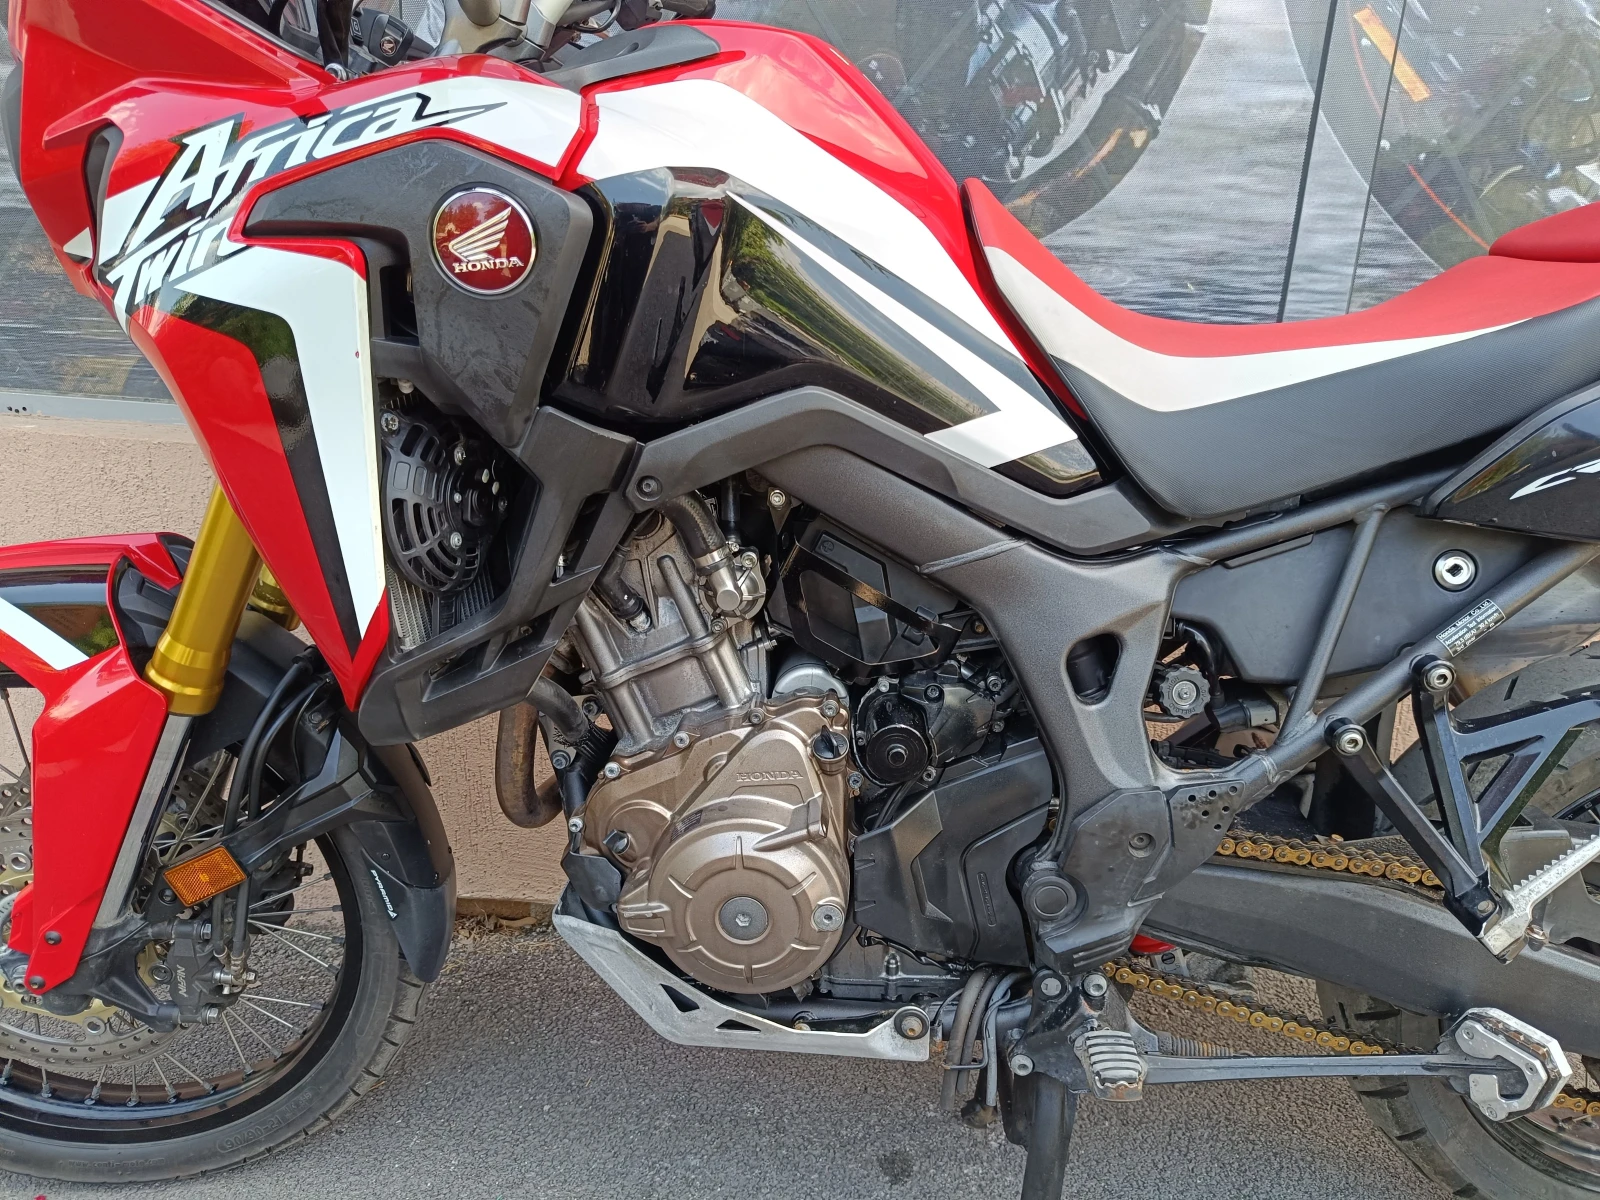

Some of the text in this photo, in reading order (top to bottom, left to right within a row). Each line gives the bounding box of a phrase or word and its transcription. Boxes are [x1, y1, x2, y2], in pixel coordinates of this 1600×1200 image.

[122, 91, 508, 256] Africa
[105, 212, 257, 311] Twin
[452, 256, 524, 273] HONDA
[1439, 626, 1456, 640] Honda
[1456, 615, 1471, 627] Motor
[1444, 605, 1498, 646] Acceleration Test Information
[735, 769, 804, 782] HONDA
[370, 869, 394, 912] PYRAMID
